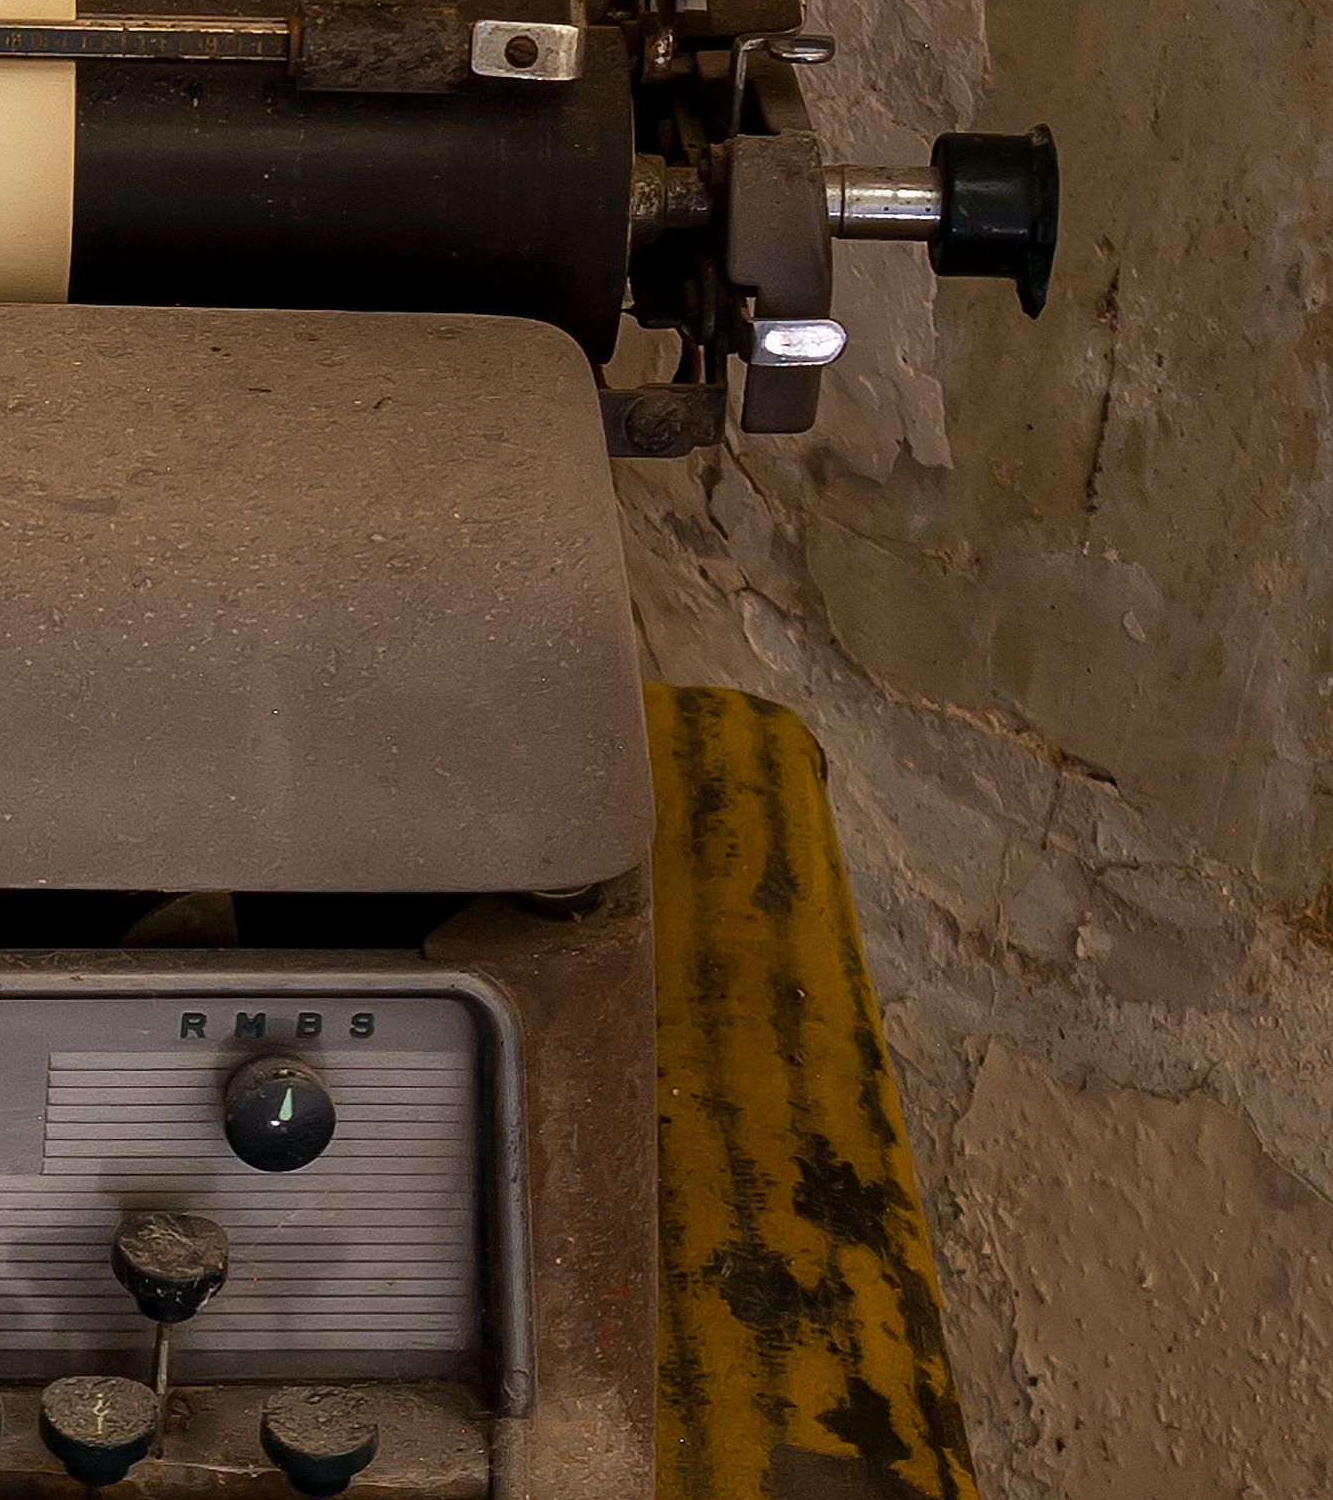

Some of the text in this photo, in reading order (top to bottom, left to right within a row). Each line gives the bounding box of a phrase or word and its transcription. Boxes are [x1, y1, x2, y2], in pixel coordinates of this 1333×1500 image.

[180, 1012, 376, 1039] R M B S
